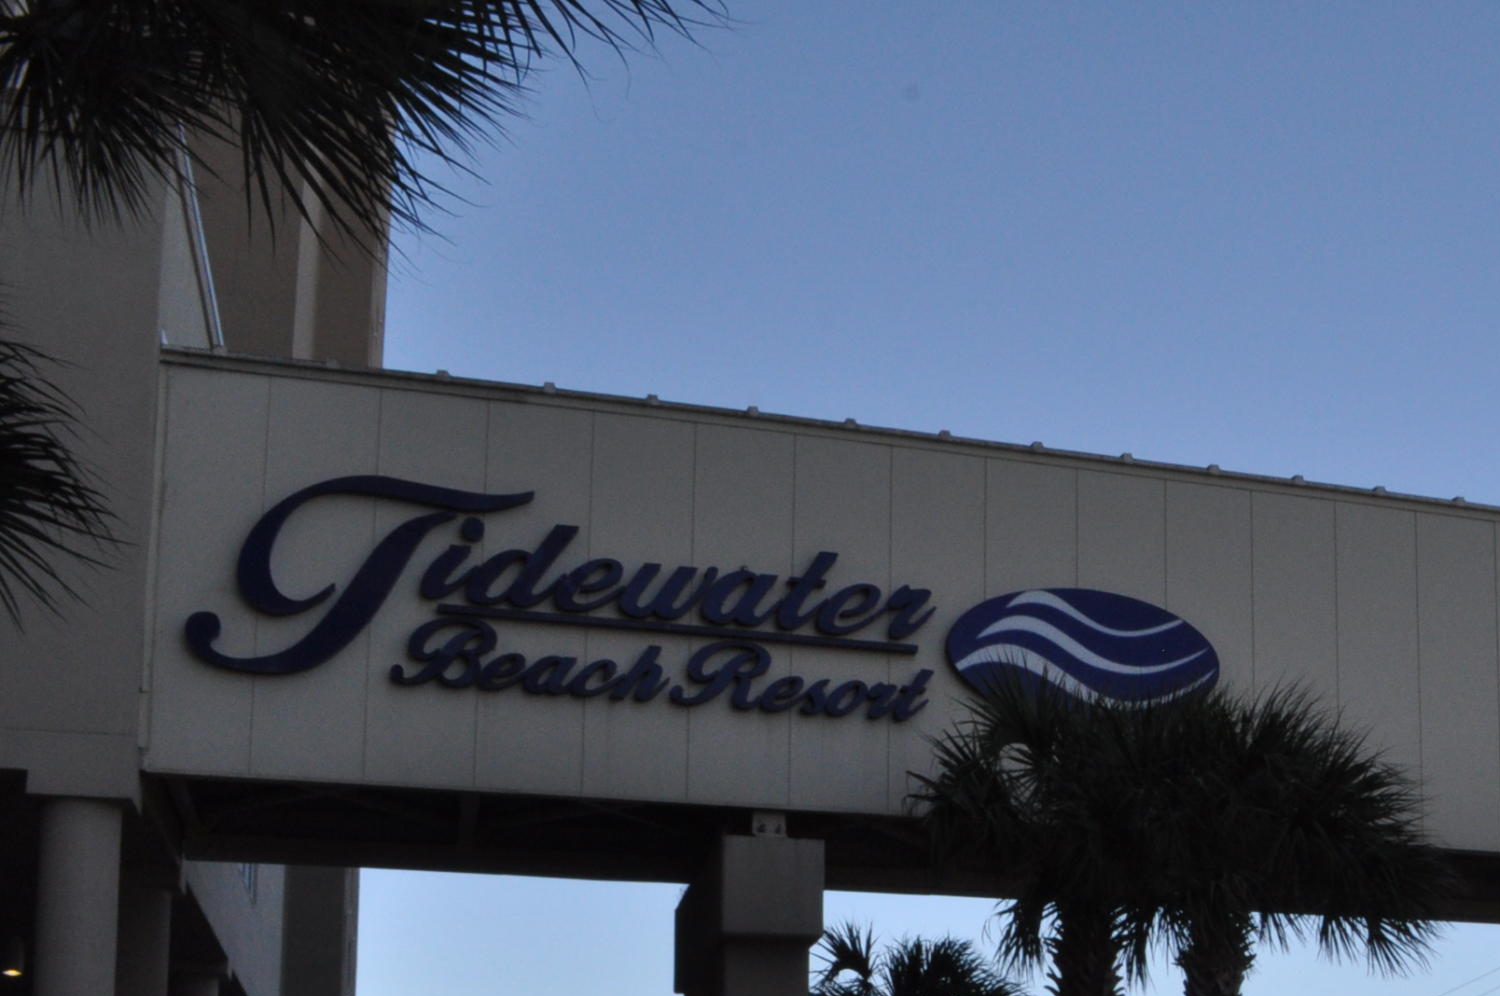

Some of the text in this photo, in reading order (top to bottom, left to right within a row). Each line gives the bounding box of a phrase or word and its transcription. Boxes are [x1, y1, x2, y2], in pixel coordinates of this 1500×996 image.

[184, 474, 937, 676] Tidewater
[390, 617, 935, 721] Beach Resort
